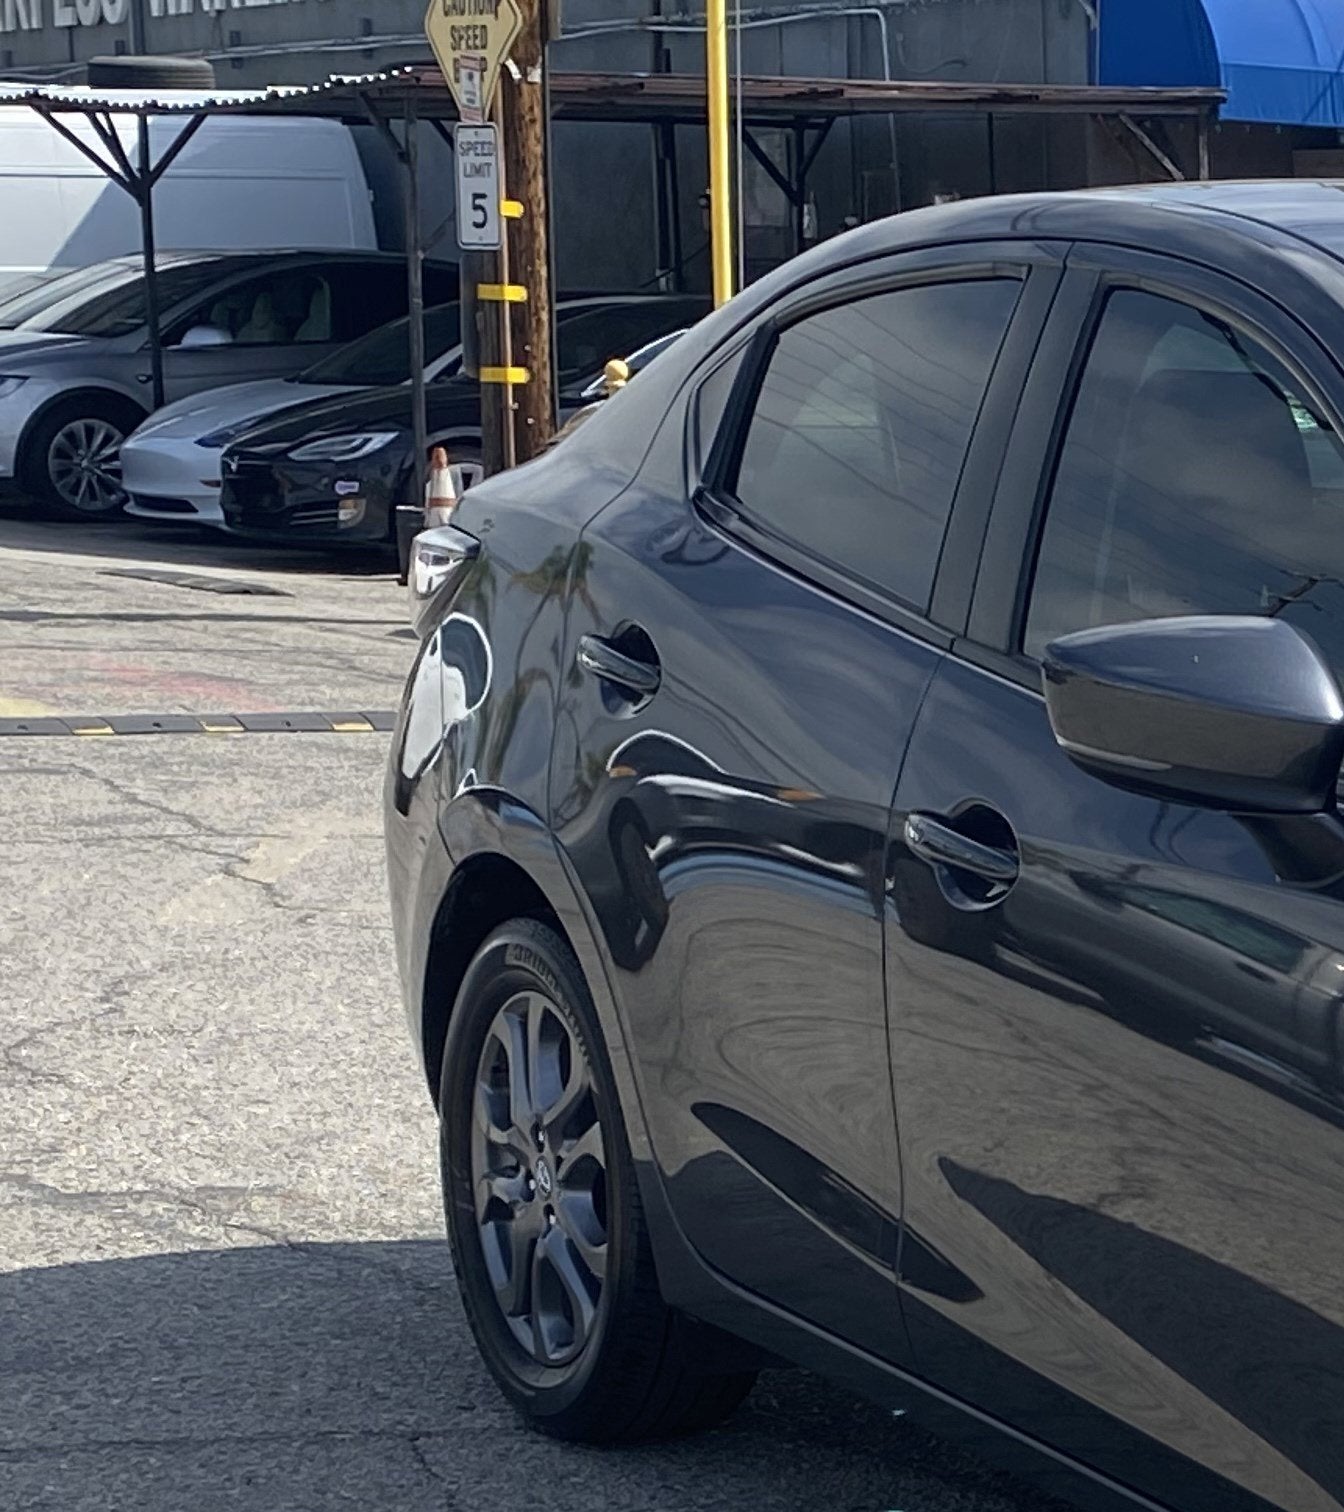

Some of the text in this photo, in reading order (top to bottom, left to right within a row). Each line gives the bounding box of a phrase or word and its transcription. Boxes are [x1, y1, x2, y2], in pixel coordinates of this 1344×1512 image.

[450, 24, 488, 51] SPEED
[452, 55, 488, 84] BP
[458, 141, 496, 156] SPEED
[463, 161, 493, 178] LIMIT
[471, 192, 488, 229] 5
